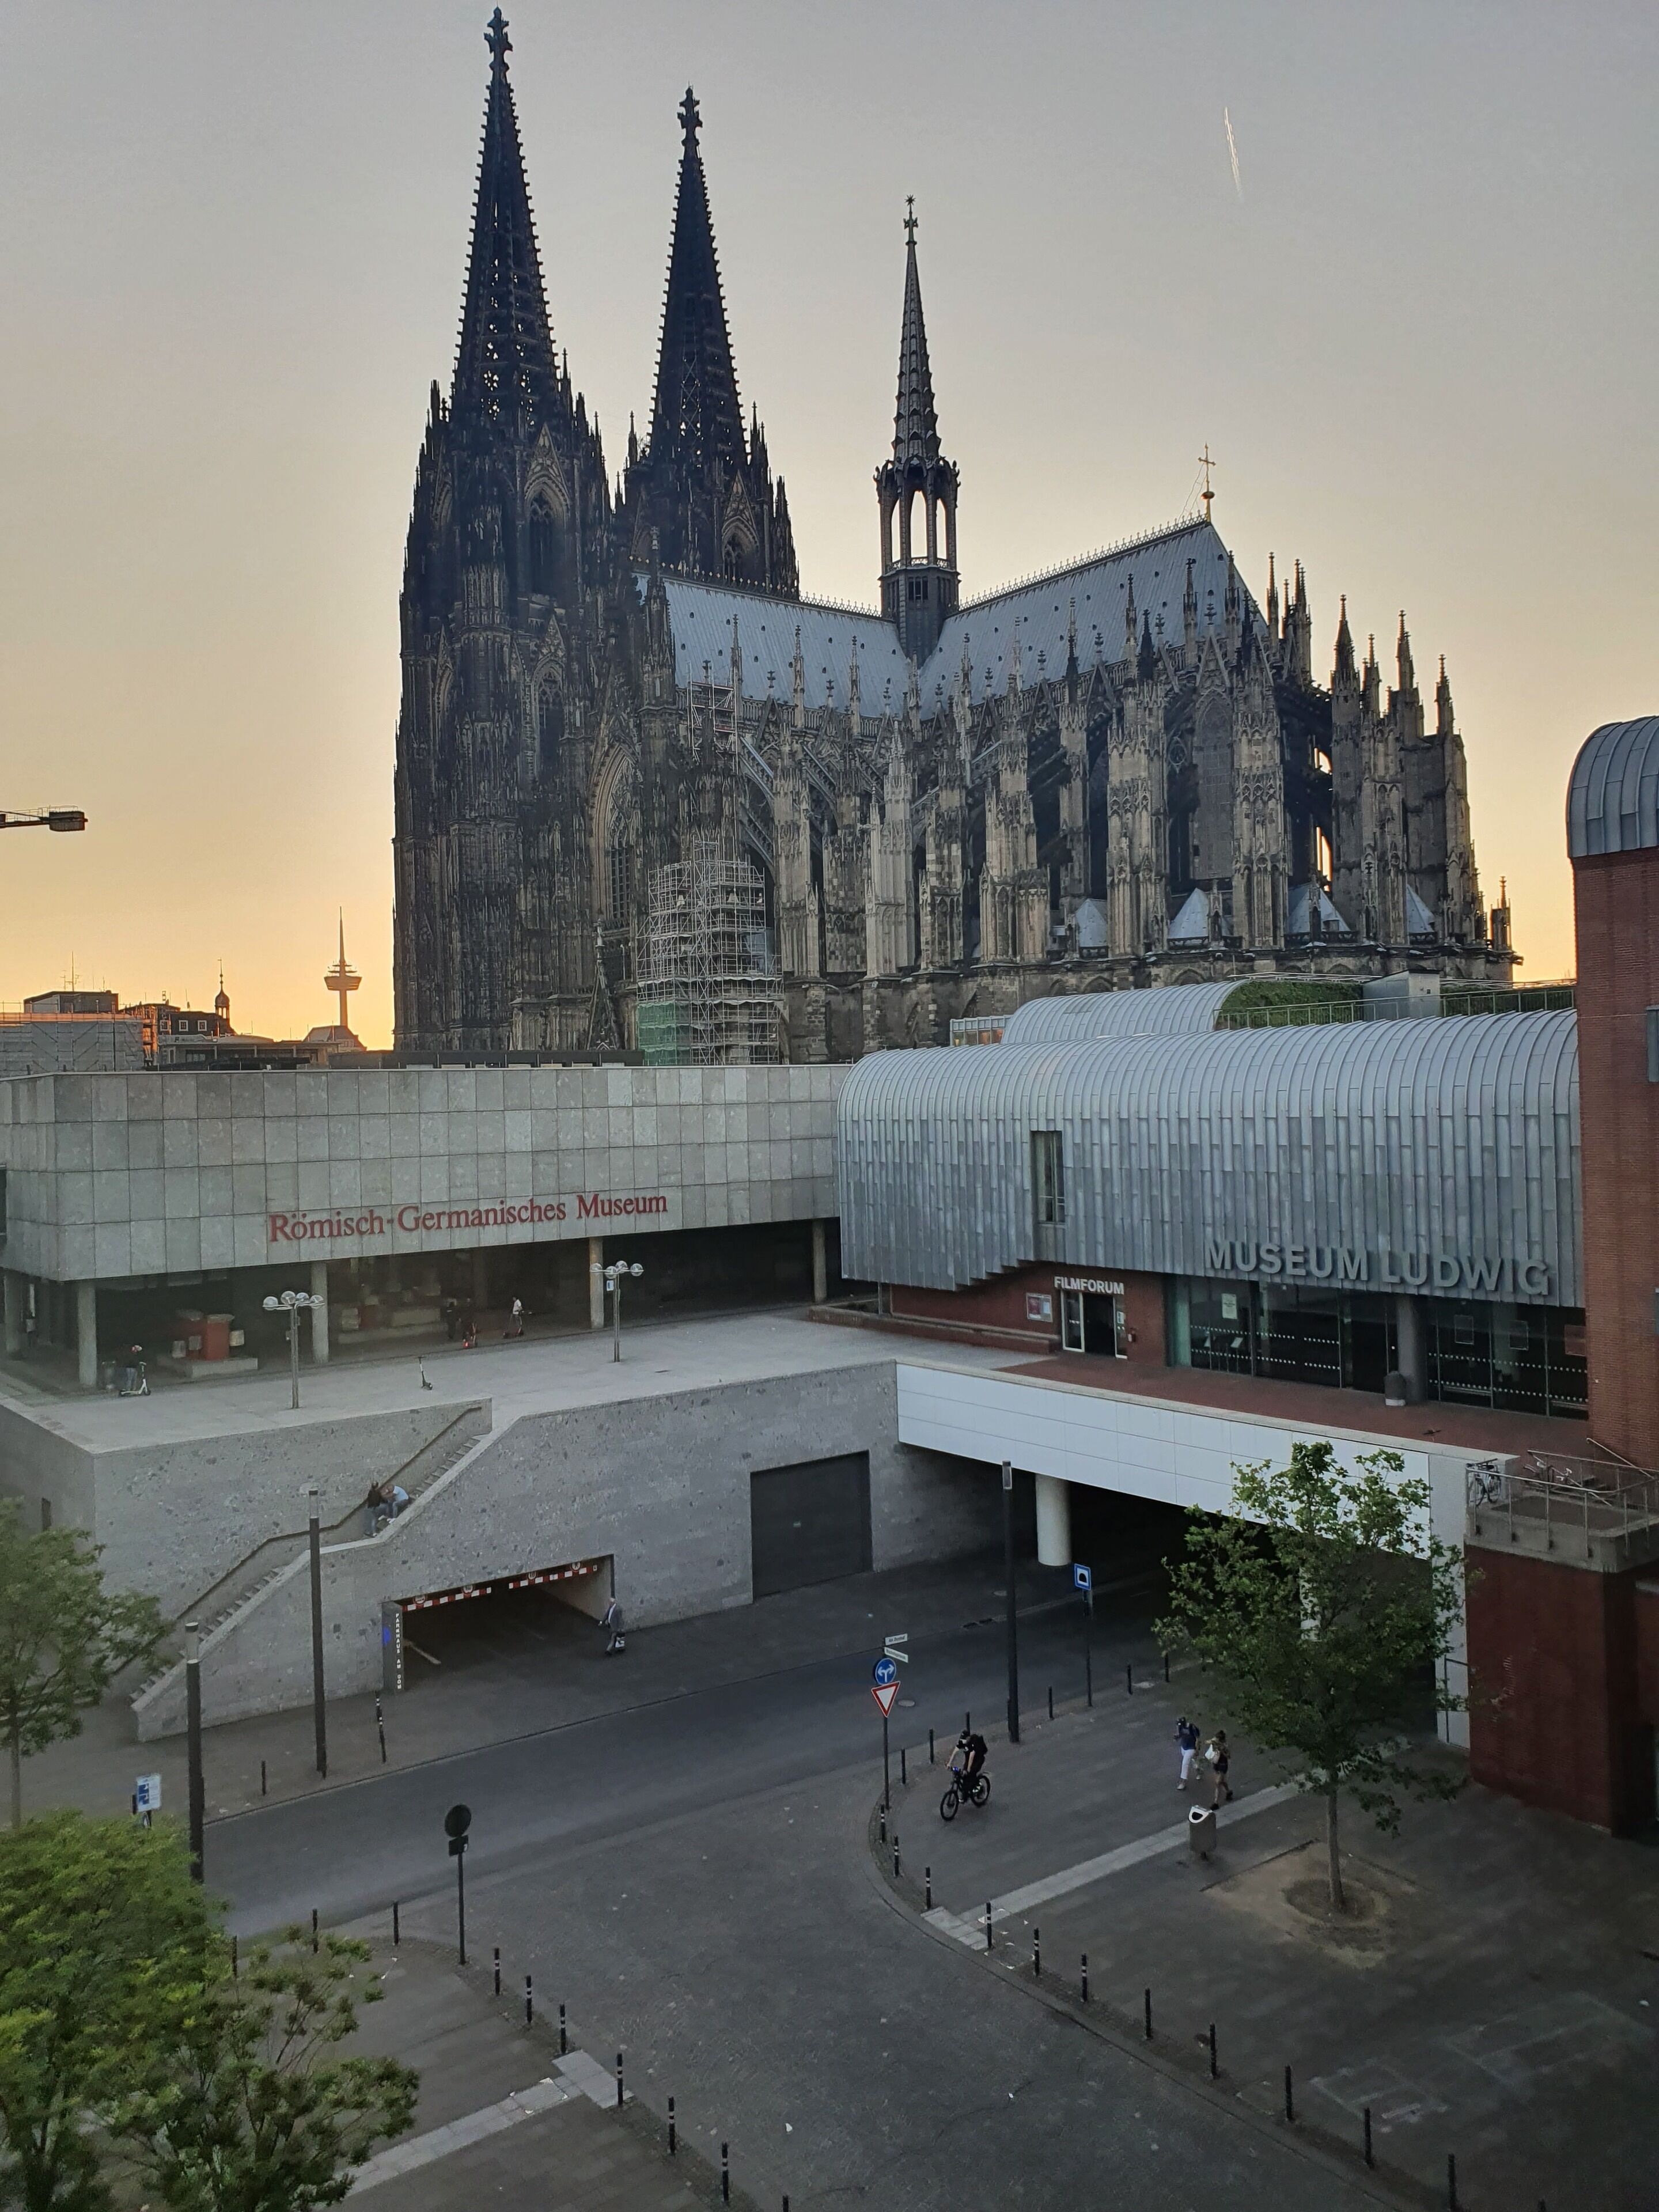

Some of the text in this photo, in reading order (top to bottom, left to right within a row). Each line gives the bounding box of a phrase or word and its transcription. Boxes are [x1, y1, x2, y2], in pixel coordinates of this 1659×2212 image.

[577, 1192, 668, 1219] Museum
[1205, 1239, 1550, 1296] MUSEUM LUDWIG
[1054, 1275, 1124, 1296] FILMFORUM
